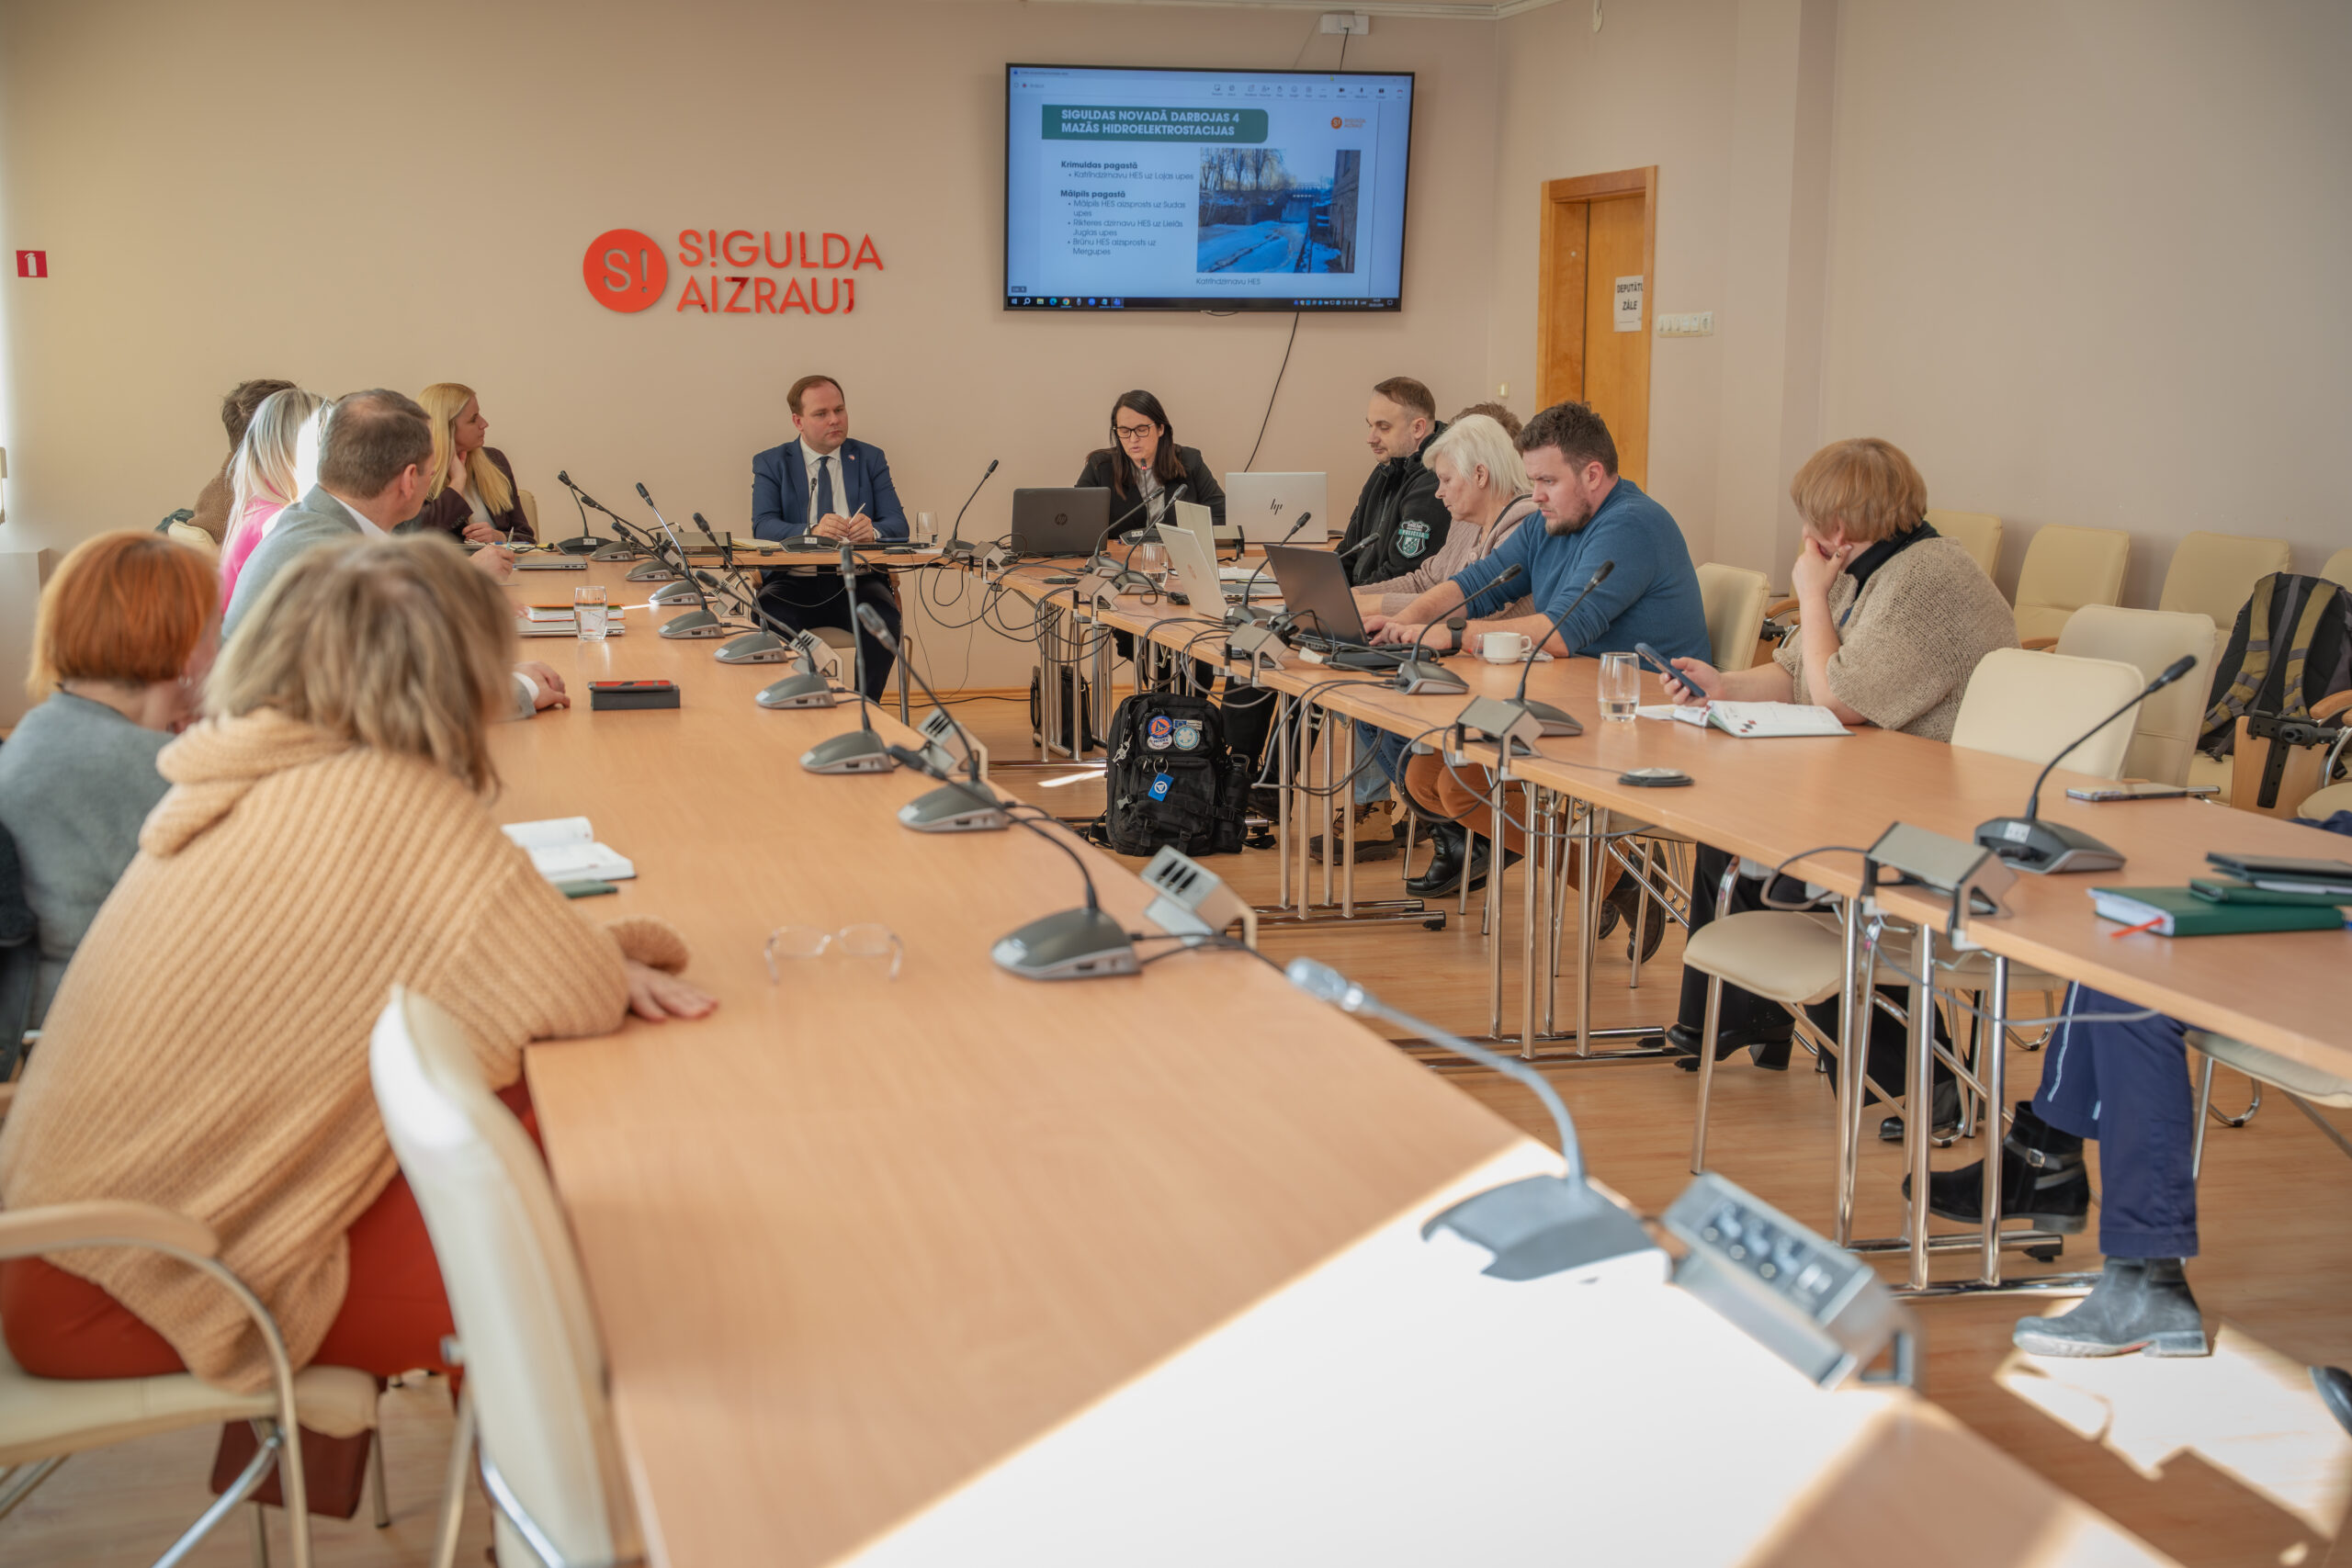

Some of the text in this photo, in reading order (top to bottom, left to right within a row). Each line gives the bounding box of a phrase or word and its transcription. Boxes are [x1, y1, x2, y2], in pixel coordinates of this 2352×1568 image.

[1061, 109, 1239, 123] SIGULDAS NOVADĀ DARBOJAS 4
[1061, 122, 1235, 135] MAZĀS HIDROELEKTROSTACIJAS
[1061, 161, 1138, 171] Krimuldas pagastā
[1155, 172, 1173, 181] Lojas
[1175, 174, 1193, 182] upes
[1060, 190, 1125, 199] Mālpils pagastā
[1073, 199, 1100, 209] Mālpils
[1116, 200, 1151, 209] aizsprosts
[1103, 219, 1136, 227] dzirnavu
[1073, 229, 1097, 238] Juglas
[1112, 239, 1147, 248] aizsprosts
[603, 248, 649, 294] S!
[676, 275, 854, 314] AIZRAUJ
[1623, 299, 1637, 310] ZĀLE
